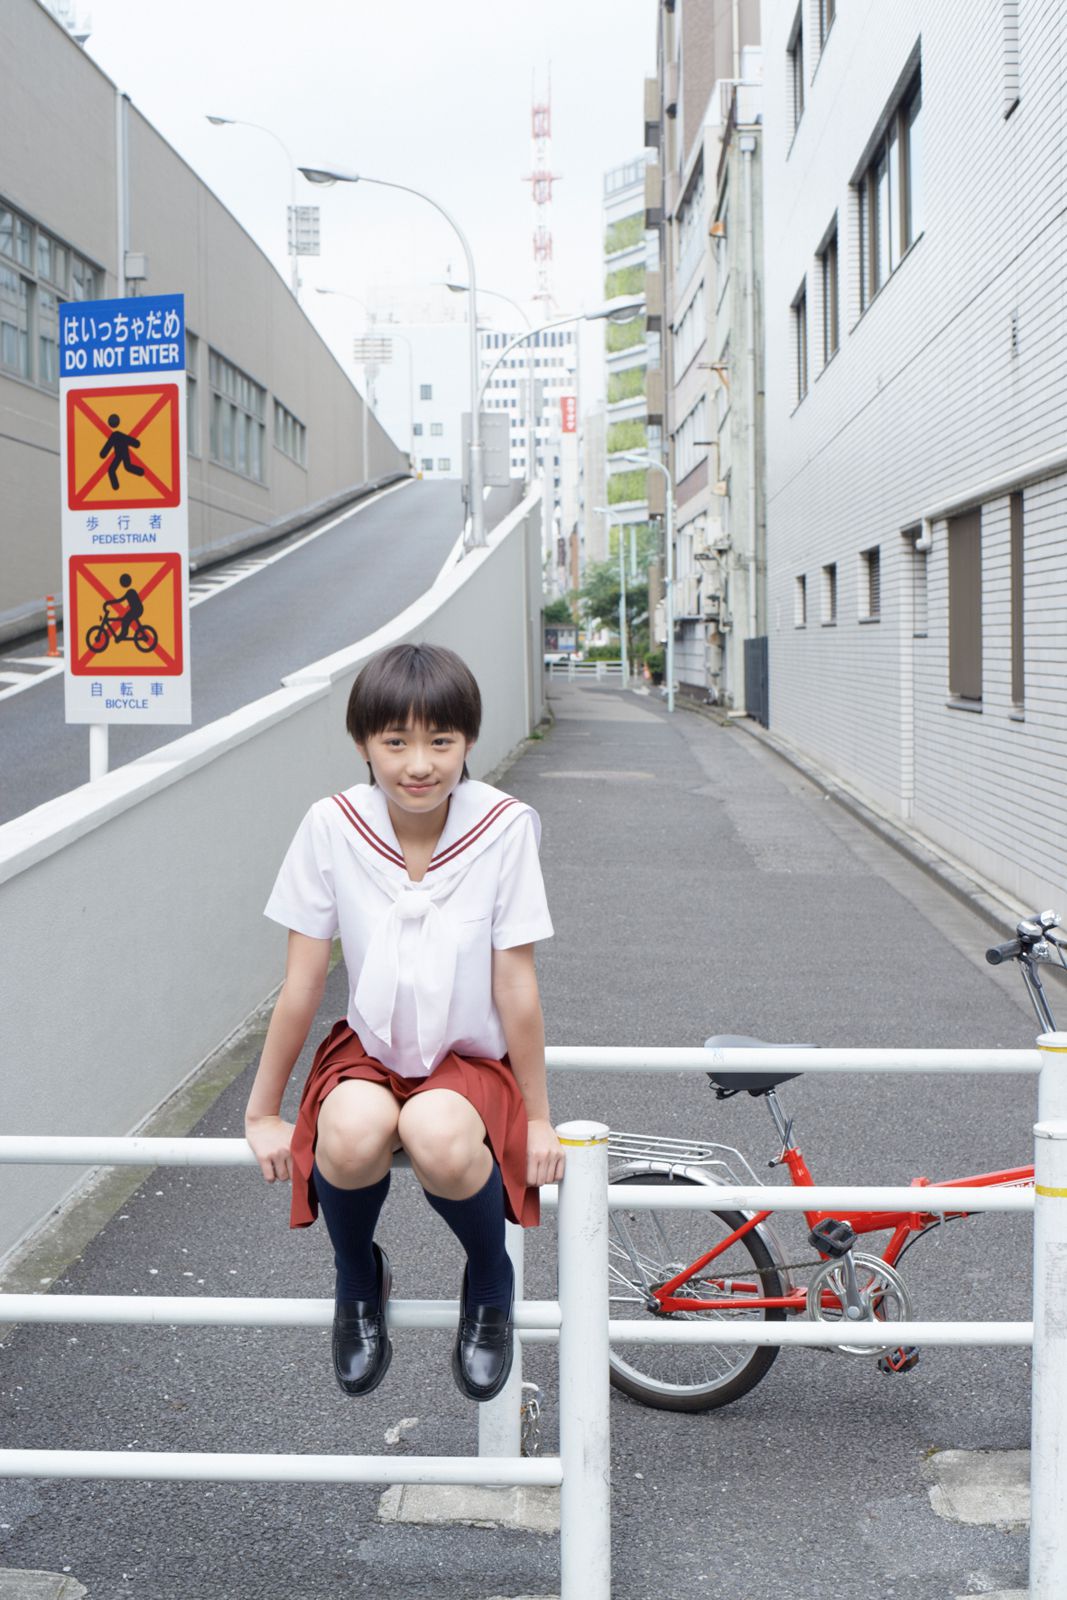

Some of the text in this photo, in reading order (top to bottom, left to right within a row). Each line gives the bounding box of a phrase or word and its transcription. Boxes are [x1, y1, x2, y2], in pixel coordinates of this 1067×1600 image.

[64, 309, 180, 345] はいっちゃだめ
[65, 343, 179, 370] DO NOT ENTER
[86, 514, 162, 531] 歩行者
[92, 533, 157, 544] PEDESTRIAN
[91, 682, 164, 697] 自転車
[105, 699, 149, 709] BICYCLE
